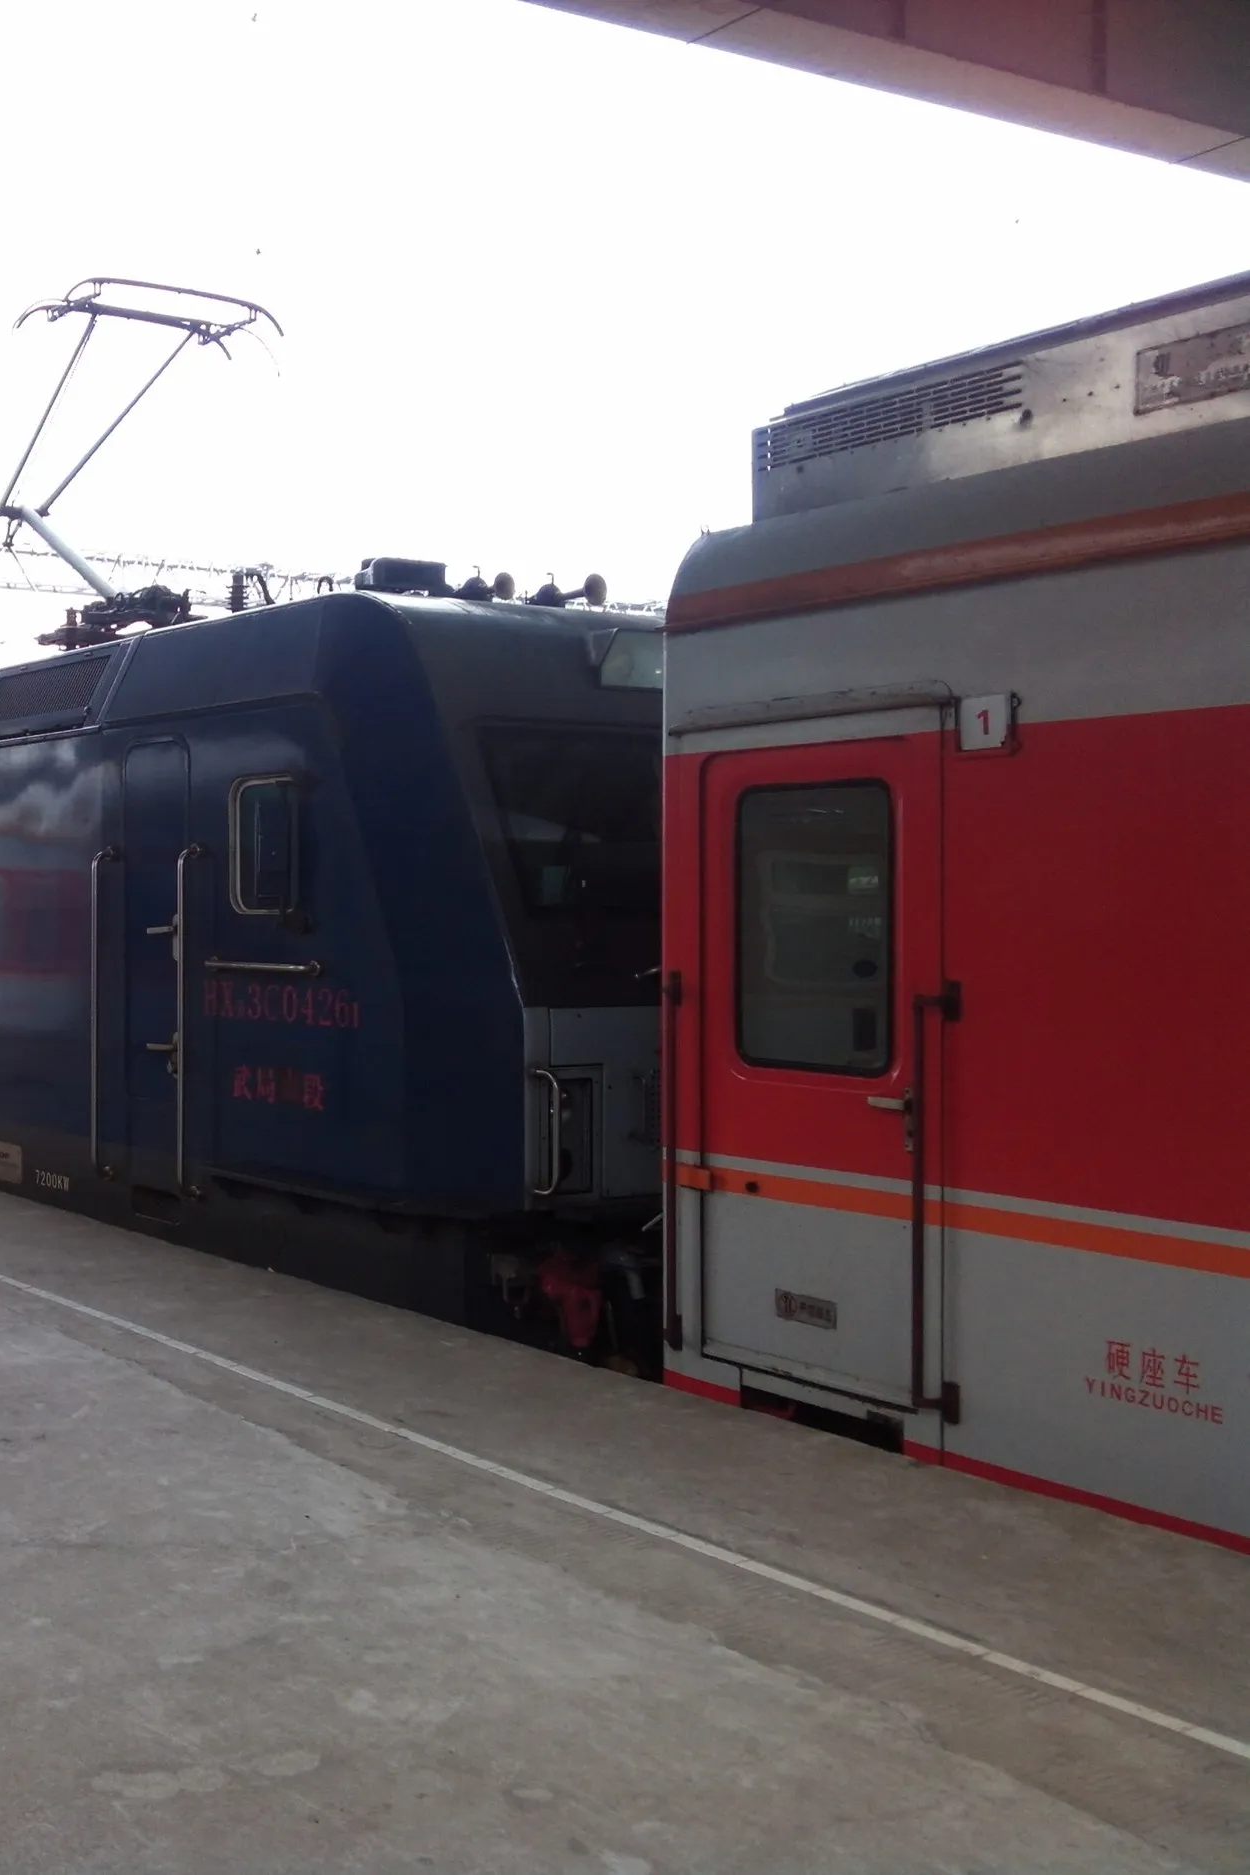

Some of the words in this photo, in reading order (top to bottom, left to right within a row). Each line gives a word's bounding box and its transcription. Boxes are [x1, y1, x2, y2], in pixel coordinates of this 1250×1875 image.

[976, 709, 989, 736] 1
[35, 1169, 70, 1192] 7200KW
[1105, 1339, 1201, 1395] 硬座车
[1084, 1375, 1224, 1425] YINGZUOCHE
